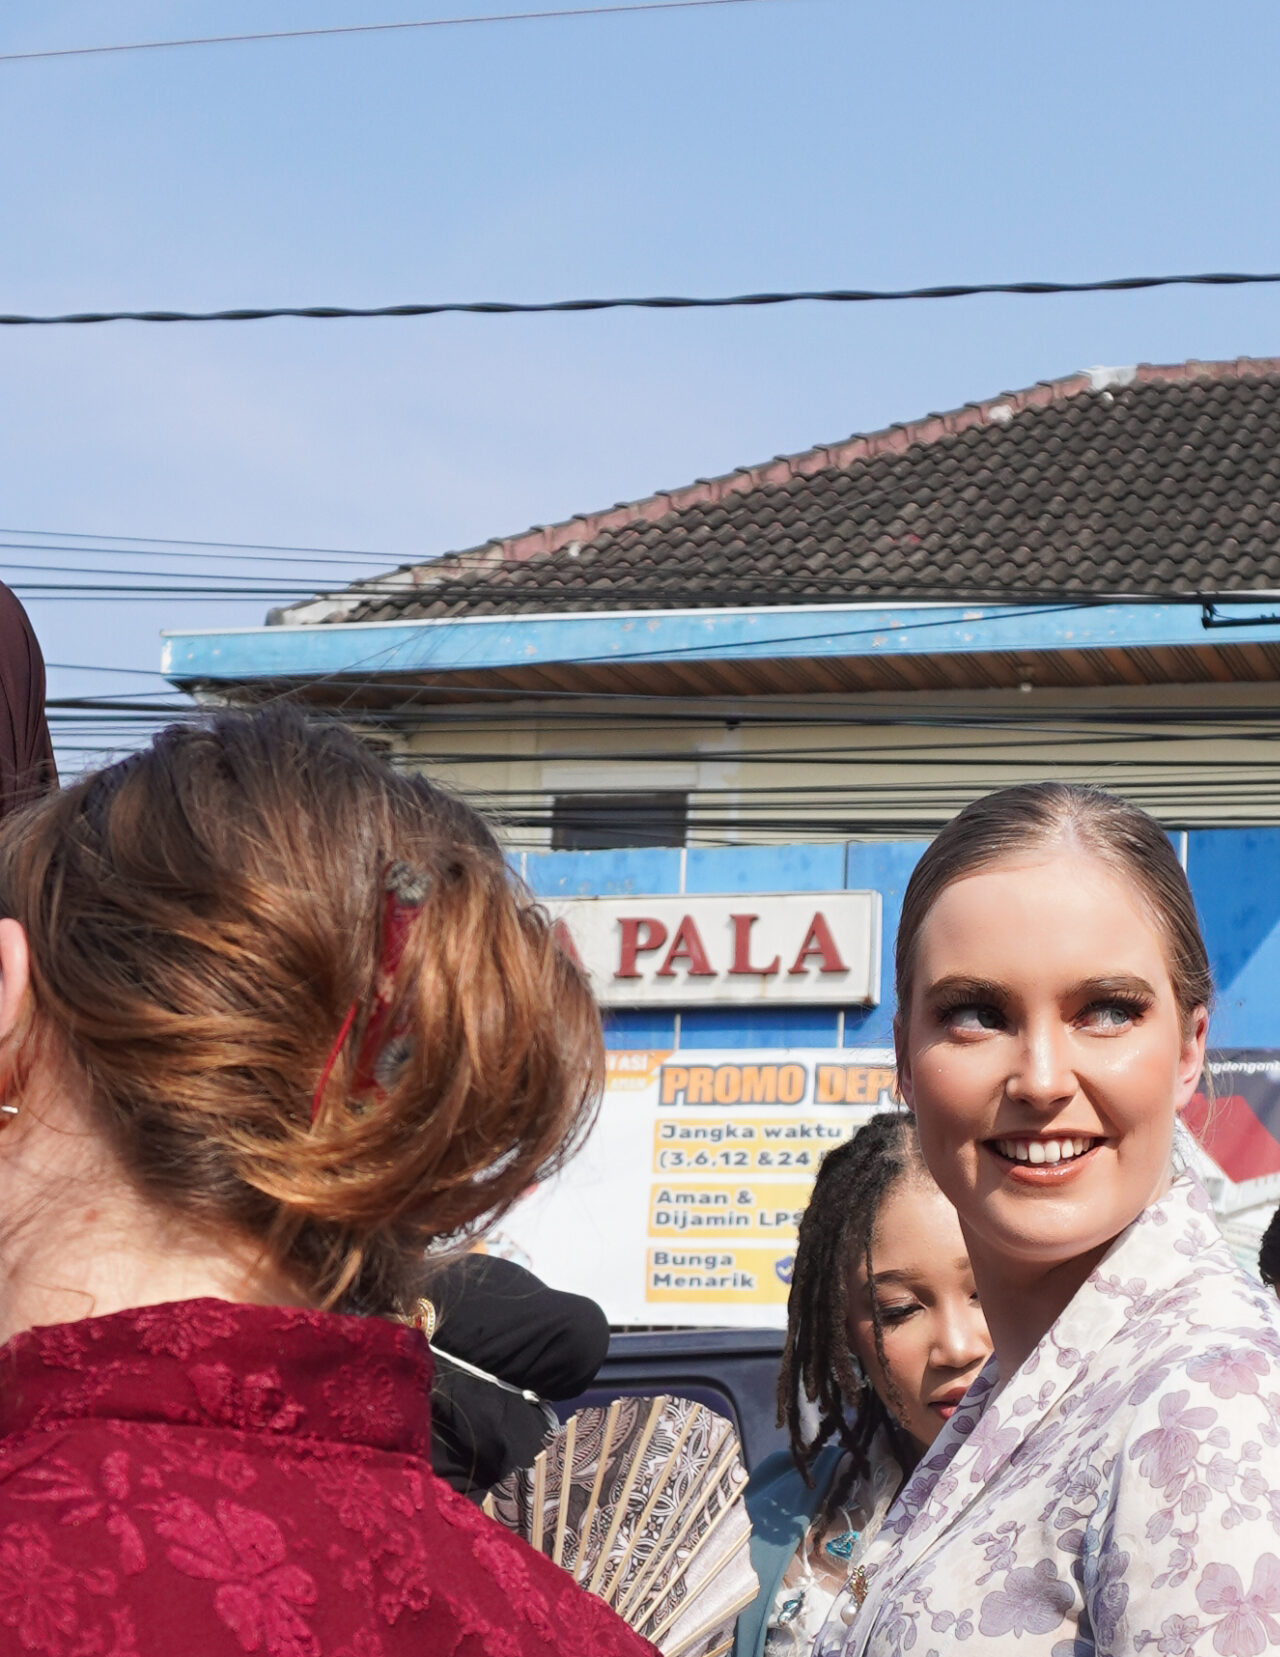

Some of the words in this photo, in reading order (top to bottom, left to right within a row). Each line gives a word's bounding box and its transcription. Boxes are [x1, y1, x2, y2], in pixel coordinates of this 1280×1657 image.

[614, 911, 850, 978] PALA
[659, 1063, 806, 1106] PROMO
[661, 1125, 755, 1142] Jangka
[764, 1124, 842, 1138] waktu
[656, 1190, 728, 1204] Aman
[737, 1190, 753, 1204] &
[655, 1211, 749, 1229] Dijamin
[654, 1252, 733, 1269] Bunga
[653, 1273, 754, 1287] Menarik
